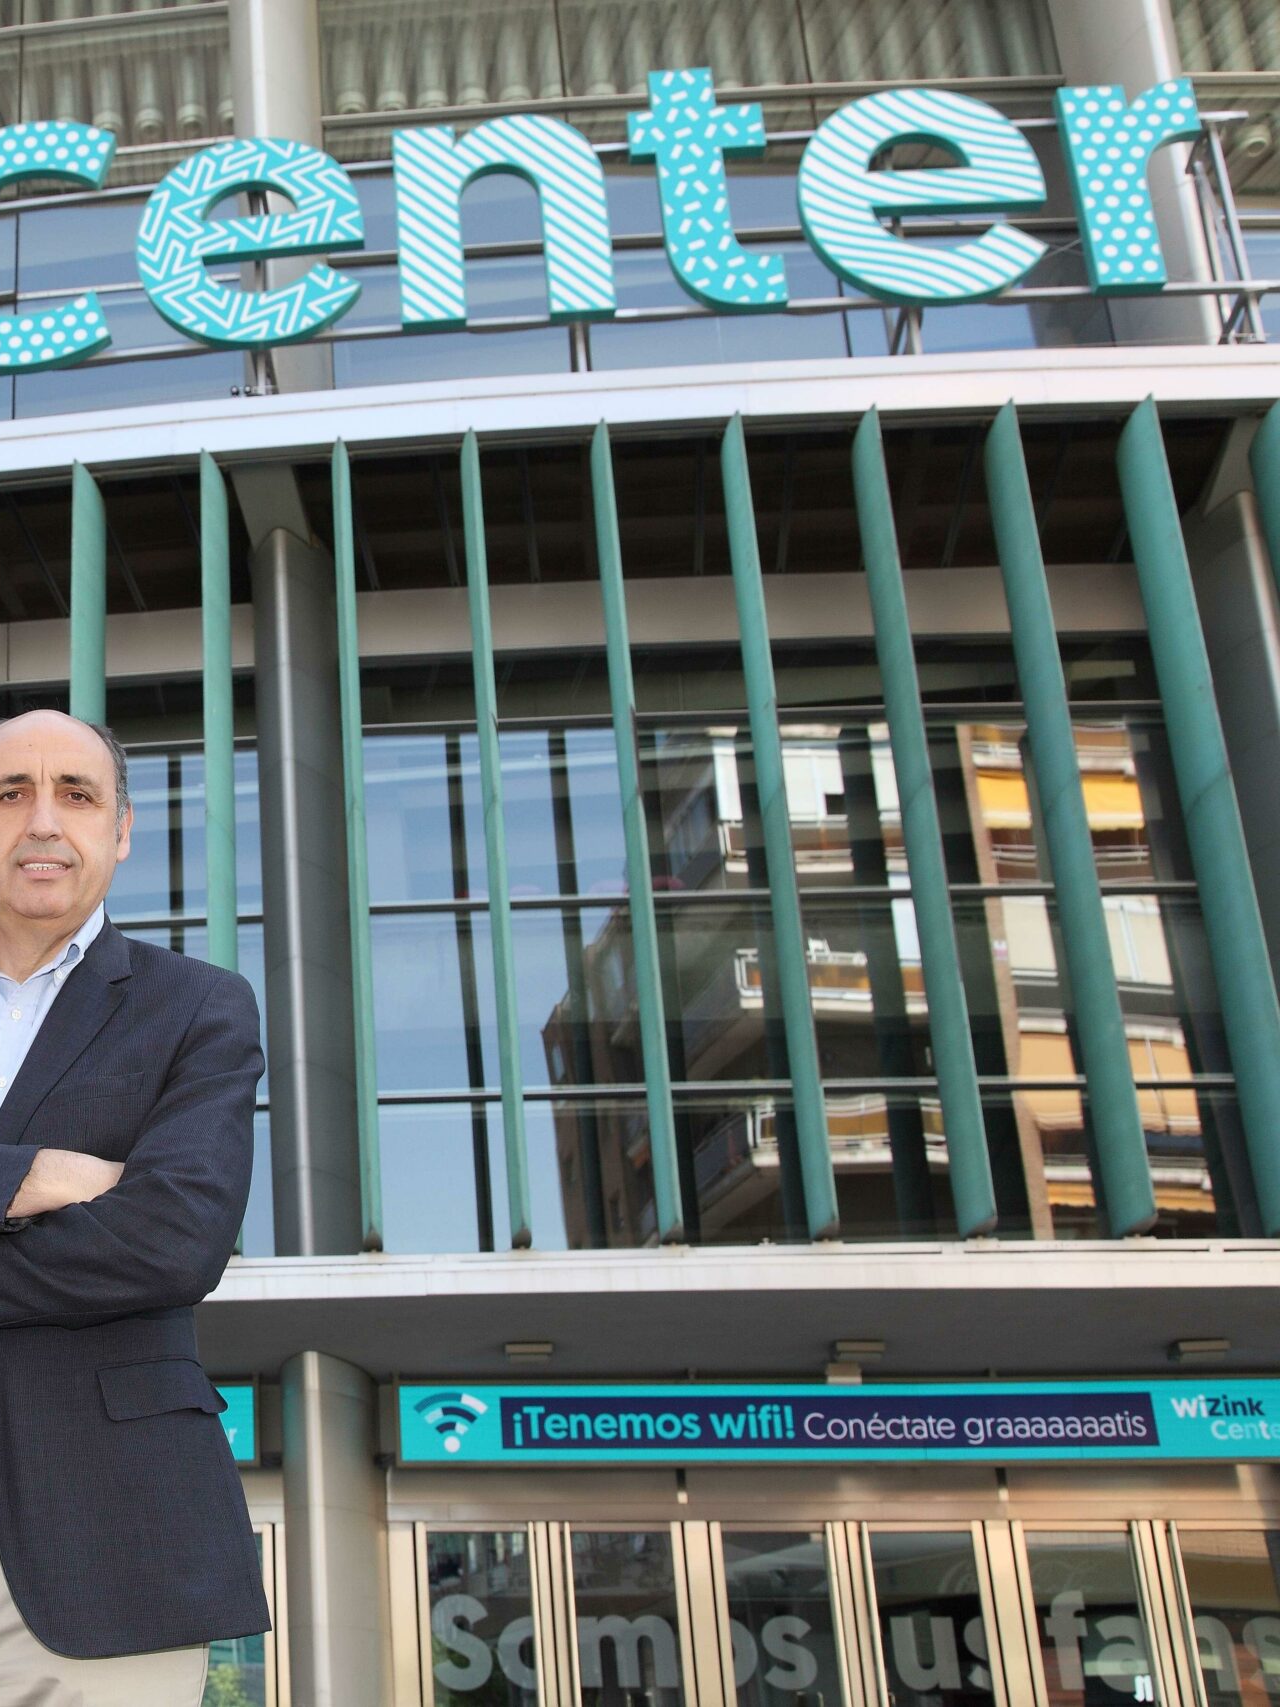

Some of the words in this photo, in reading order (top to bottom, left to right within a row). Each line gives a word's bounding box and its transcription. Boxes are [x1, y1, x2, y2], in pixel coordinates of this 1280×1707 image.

[512, 1405, 703, 1447] ¡Tenemos
[708, 1404, 797, 1440] wifi!
[803, 1411, 957, 1441] Conéctate
[962, 1410, 1148, 1445] graaaaaaatis
